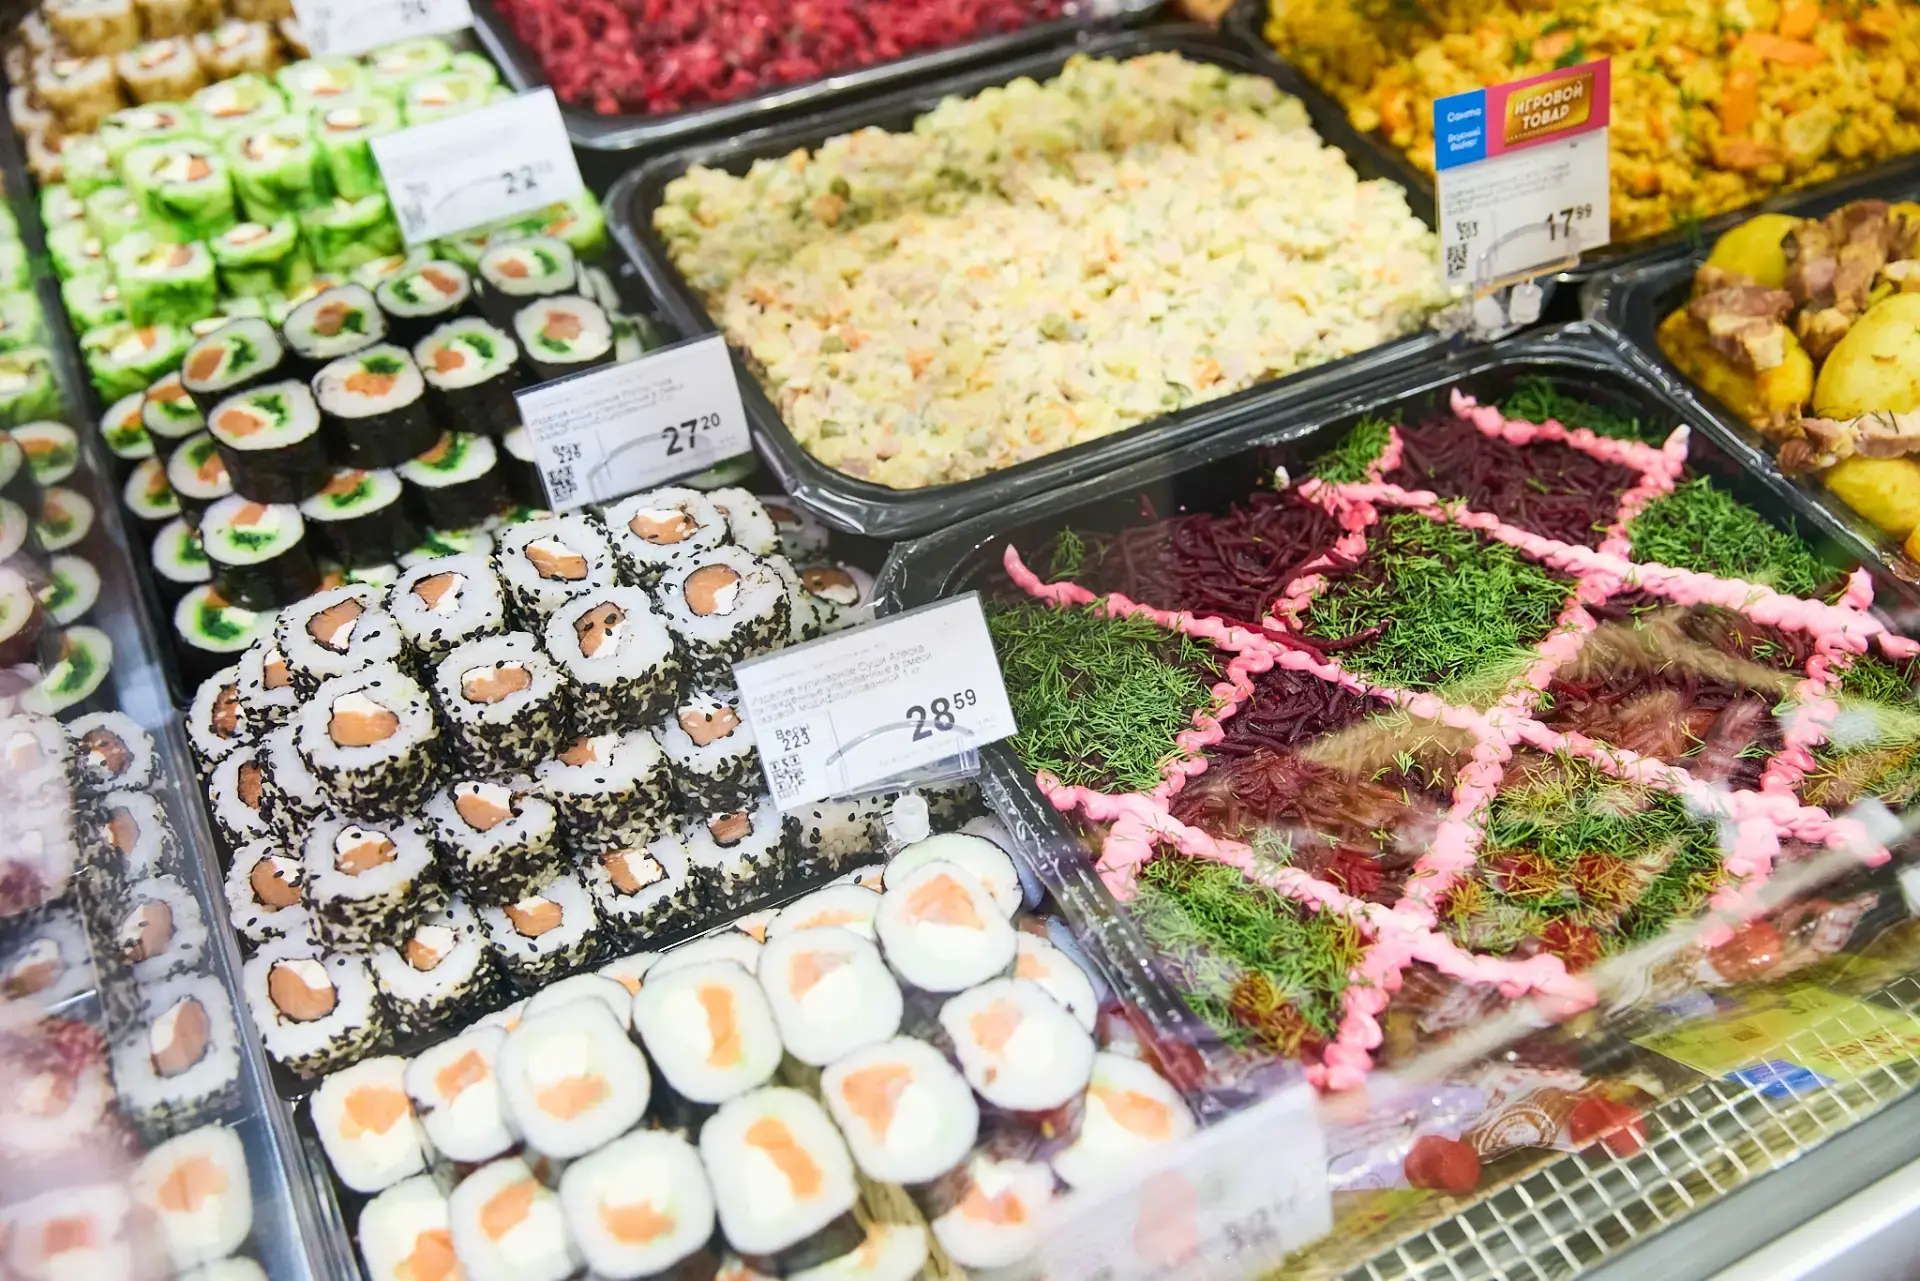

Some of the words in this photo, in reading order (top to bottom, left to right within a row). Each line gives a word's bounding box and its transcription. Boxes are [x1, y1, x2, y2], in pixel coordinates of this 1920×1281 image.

[1514, 80, 1584, 116] ИГРОВОЙ
[1522, 104, 1570, 130] ТОВАР
[502, 165, 537, 194] 22
[1546, 208, 1574, 242] 17
[1577, 204, 1593, 220] 99
[662, 419, 697, 456] 27
[700, 413, 720, 430] 20
[906, 697, 955, 742] 28
[954, 688, 977, 710] 59
[782, 733, 811, 751] 223
